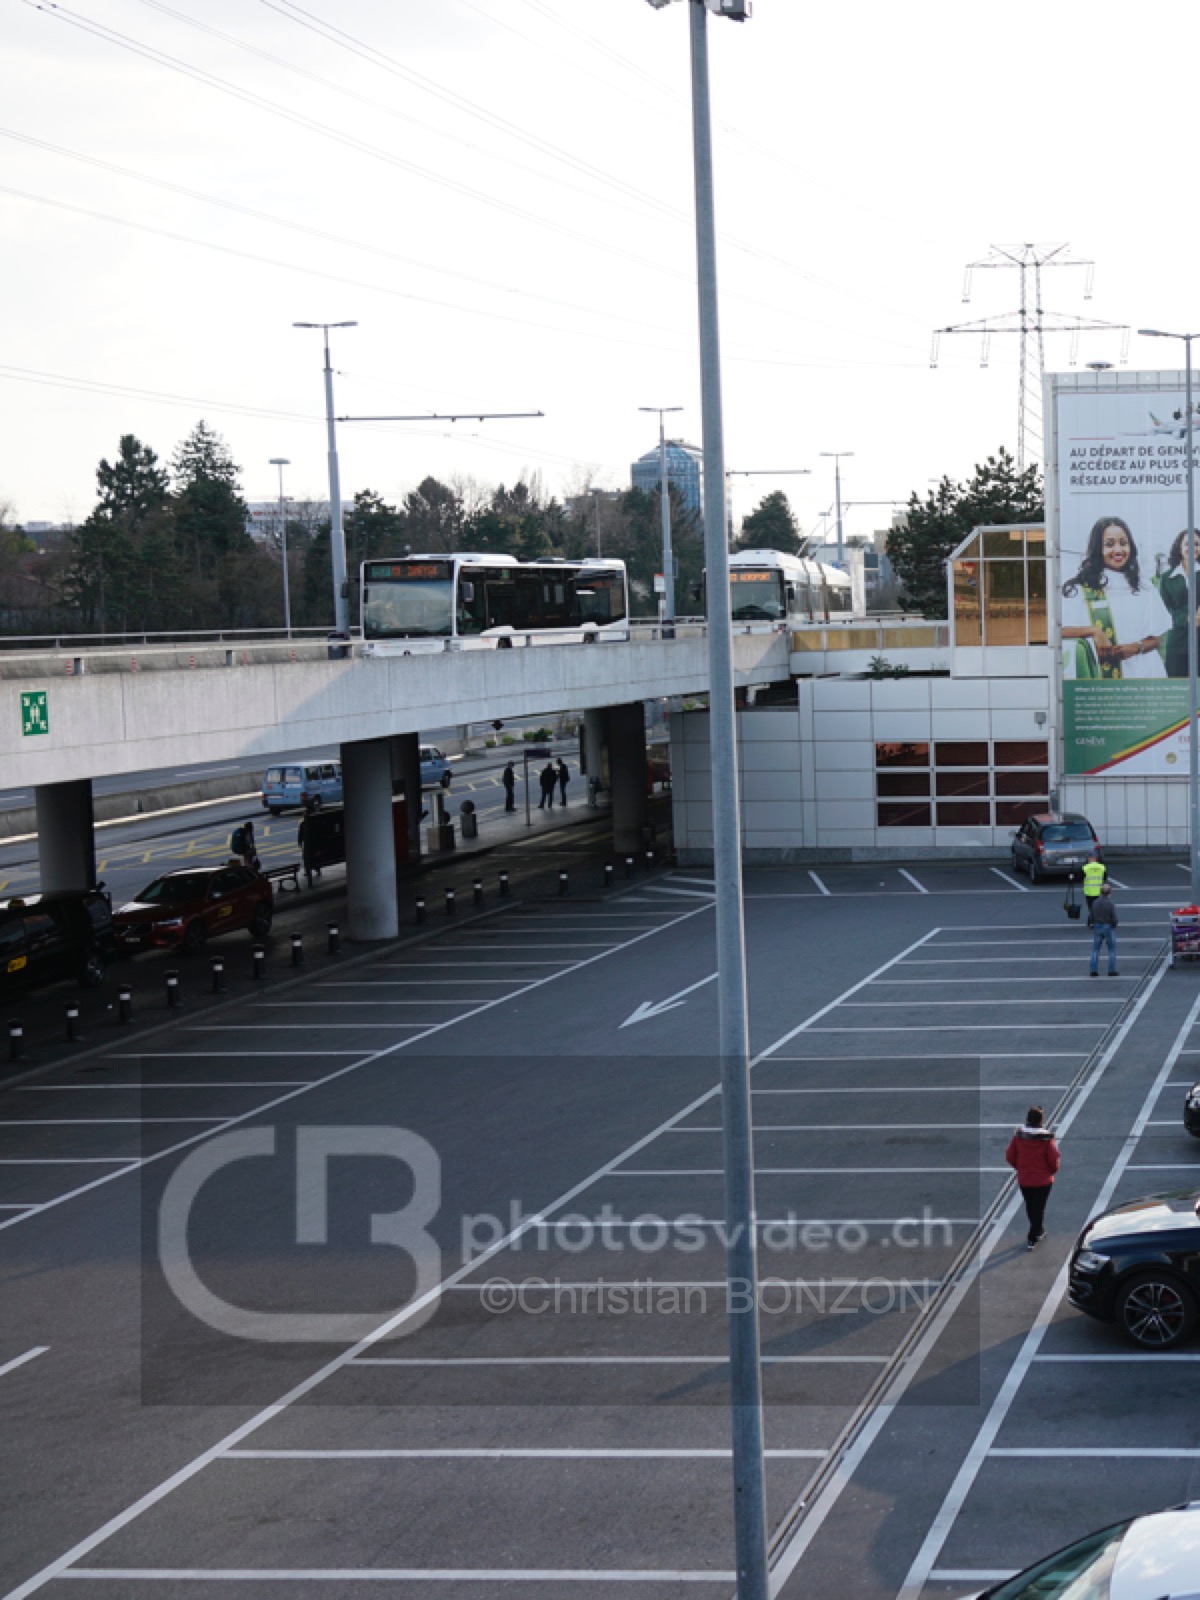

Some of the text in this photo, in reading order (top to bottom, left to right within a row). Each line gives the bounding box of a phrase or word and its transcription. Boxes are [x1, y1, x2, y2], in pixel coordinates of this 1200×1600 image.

[1070, 448, 1087, 457] AU
[1089, 443, 1136, 457] DÉPART
[1138, 446, 1155, 457] DE
[1069, 457, 1127, 471] ACCÉDEZ
[1129, 460, 1147, 470] AU
[1149, 459, 1179, 470] PLUS
[1069, 472, 1117, 486] RÉSEAU
[1119, 473, 1183, 487] D'AFRIQUE
